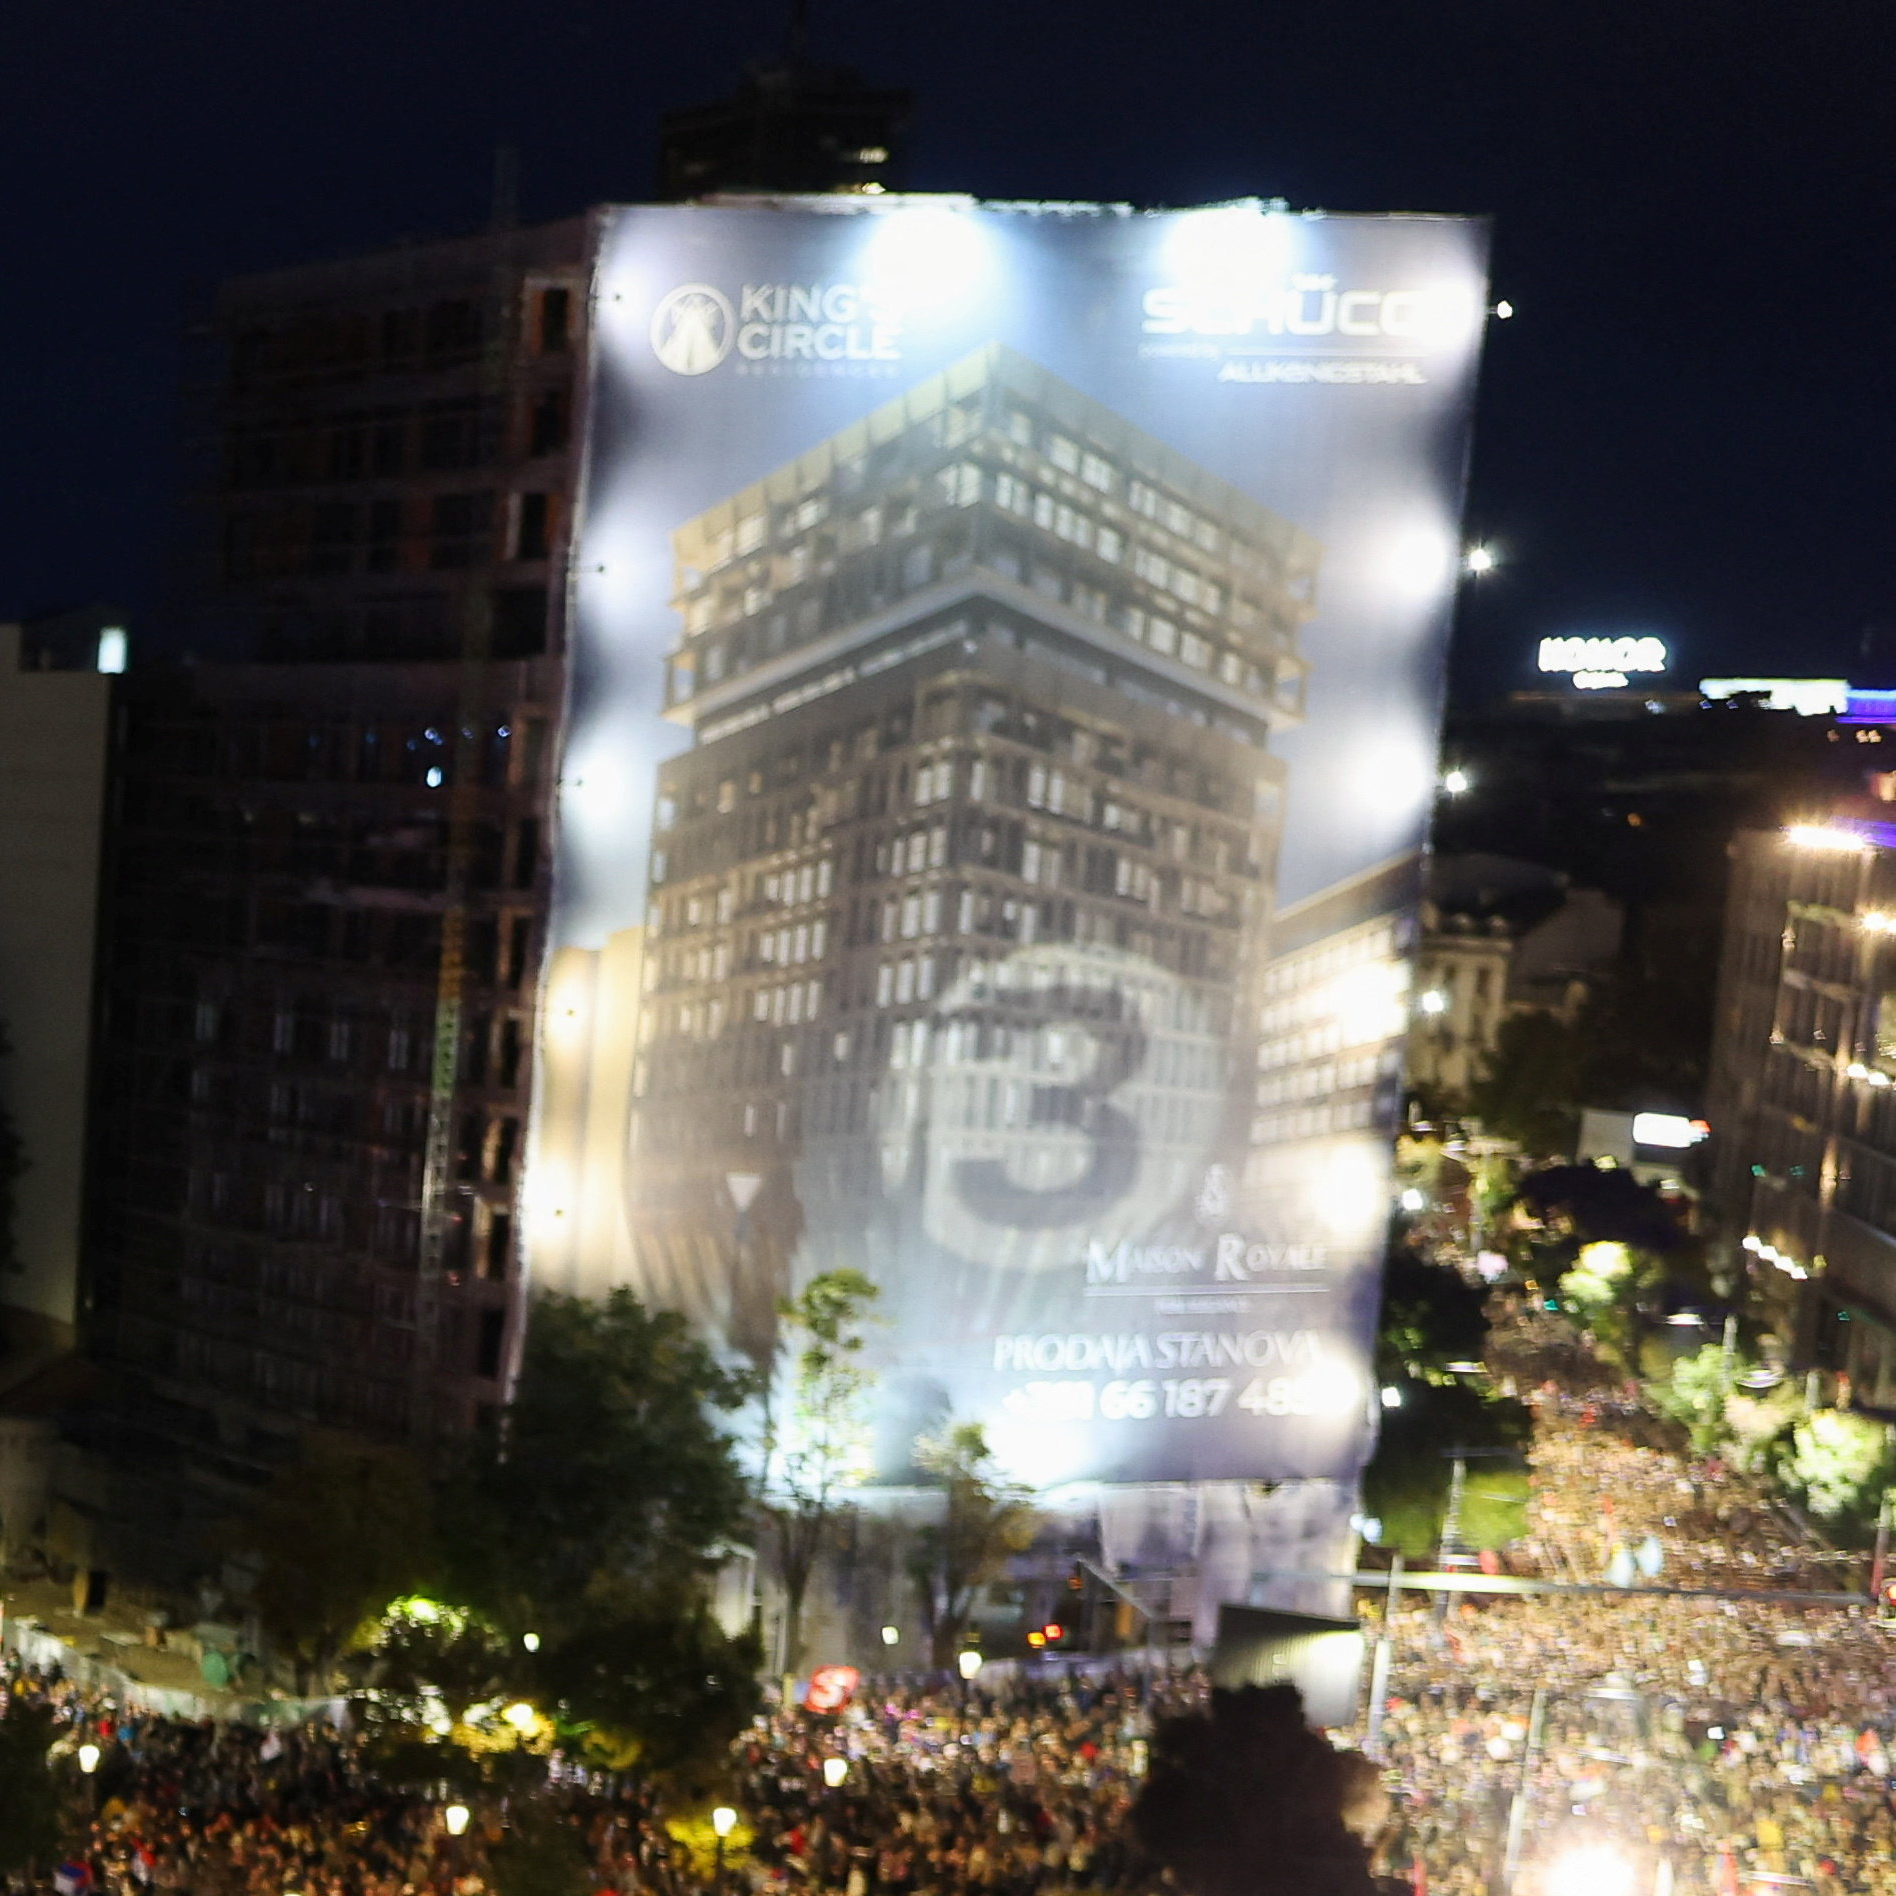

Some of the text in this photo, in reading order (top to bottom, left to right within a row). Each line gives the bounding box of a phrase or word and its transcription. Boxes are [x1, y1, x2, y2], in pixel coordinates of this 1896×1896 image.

[737, 323, 900, 361] CIRCLE
[993, 1333, 1153, 1375] PRODAJA
[1100, 1379, 1156, 1419] 66
[1162, 1378, 1231, 1418] 187
